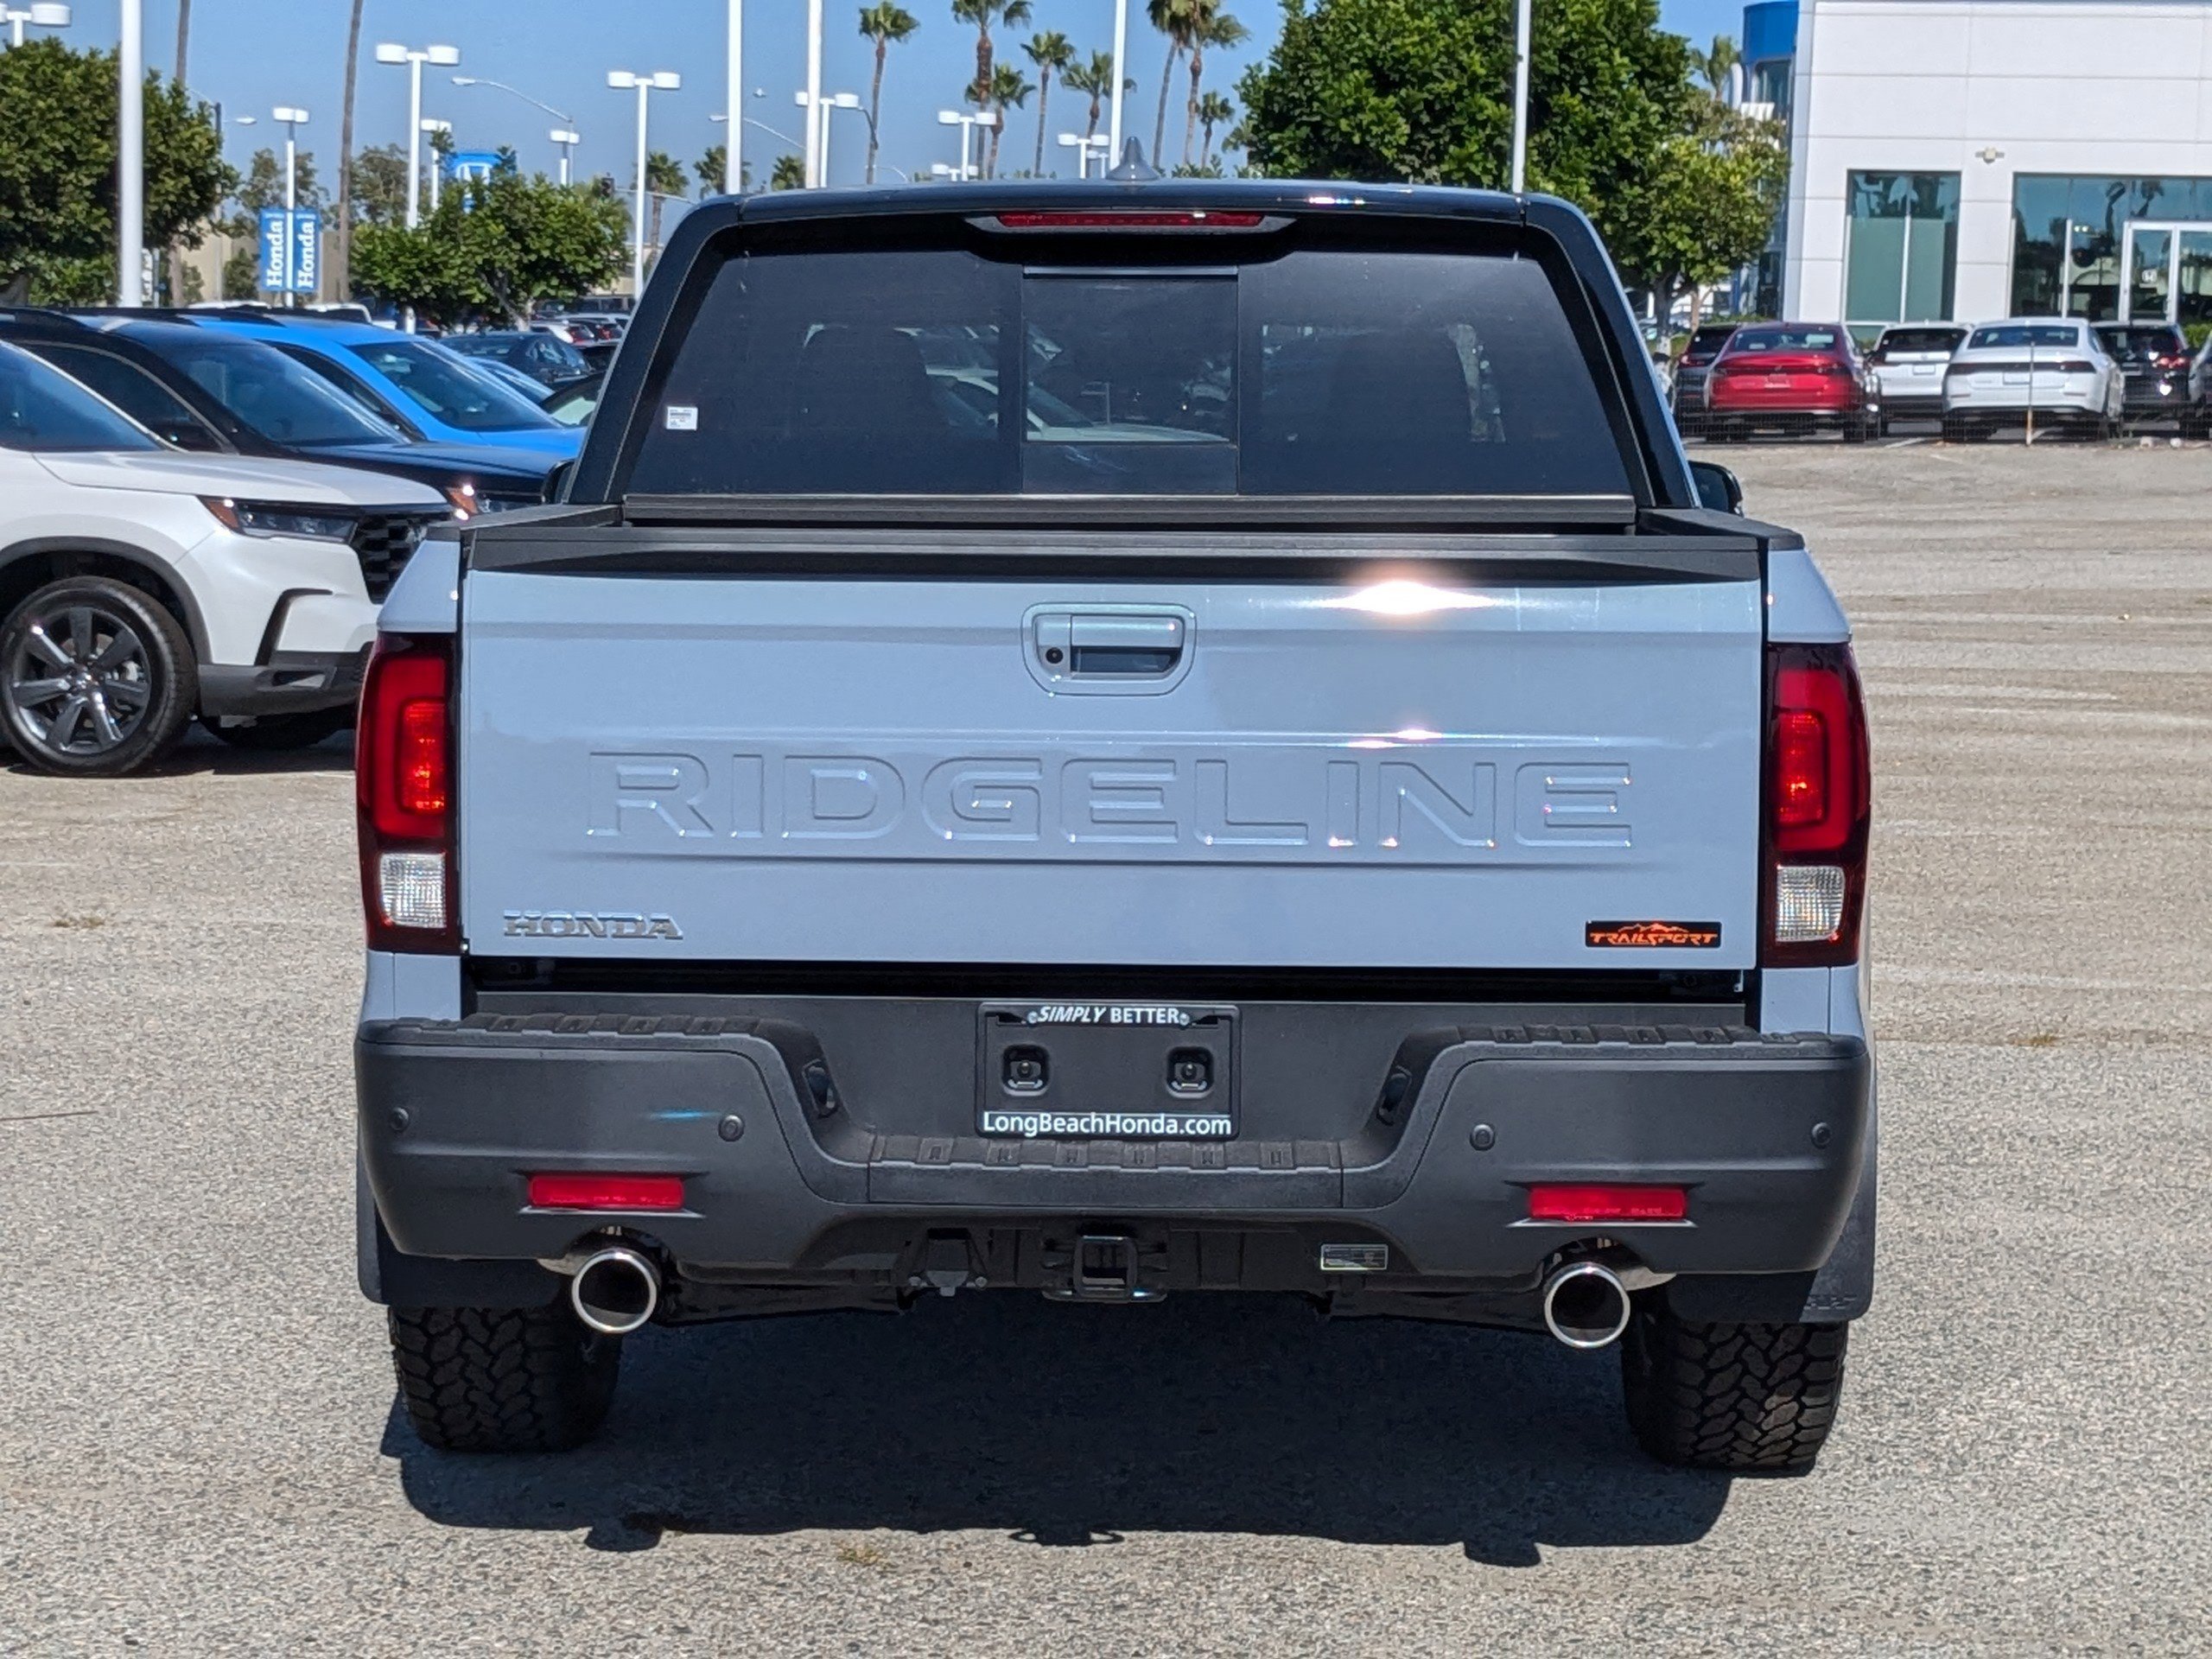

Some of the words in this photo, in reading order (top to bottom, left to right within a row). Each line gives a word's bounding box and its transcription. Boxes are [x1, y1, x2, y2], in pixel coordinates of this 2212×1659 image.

[266, 220, 283, 287] Honda
[297, 221, 315, 288] Honda
[588, 751, 1631, 848] RIDGELINE
[503, 910, 683, 939] HONDA
[1589, 932, 1719, 946] TRAILSPORT
[1037, 1006, 1107, 1023] SIMPLY
[1109, 1007, 1179, 1025] BETTER
[983, 1111, 1232, 1137] LongBeachHonda.com
